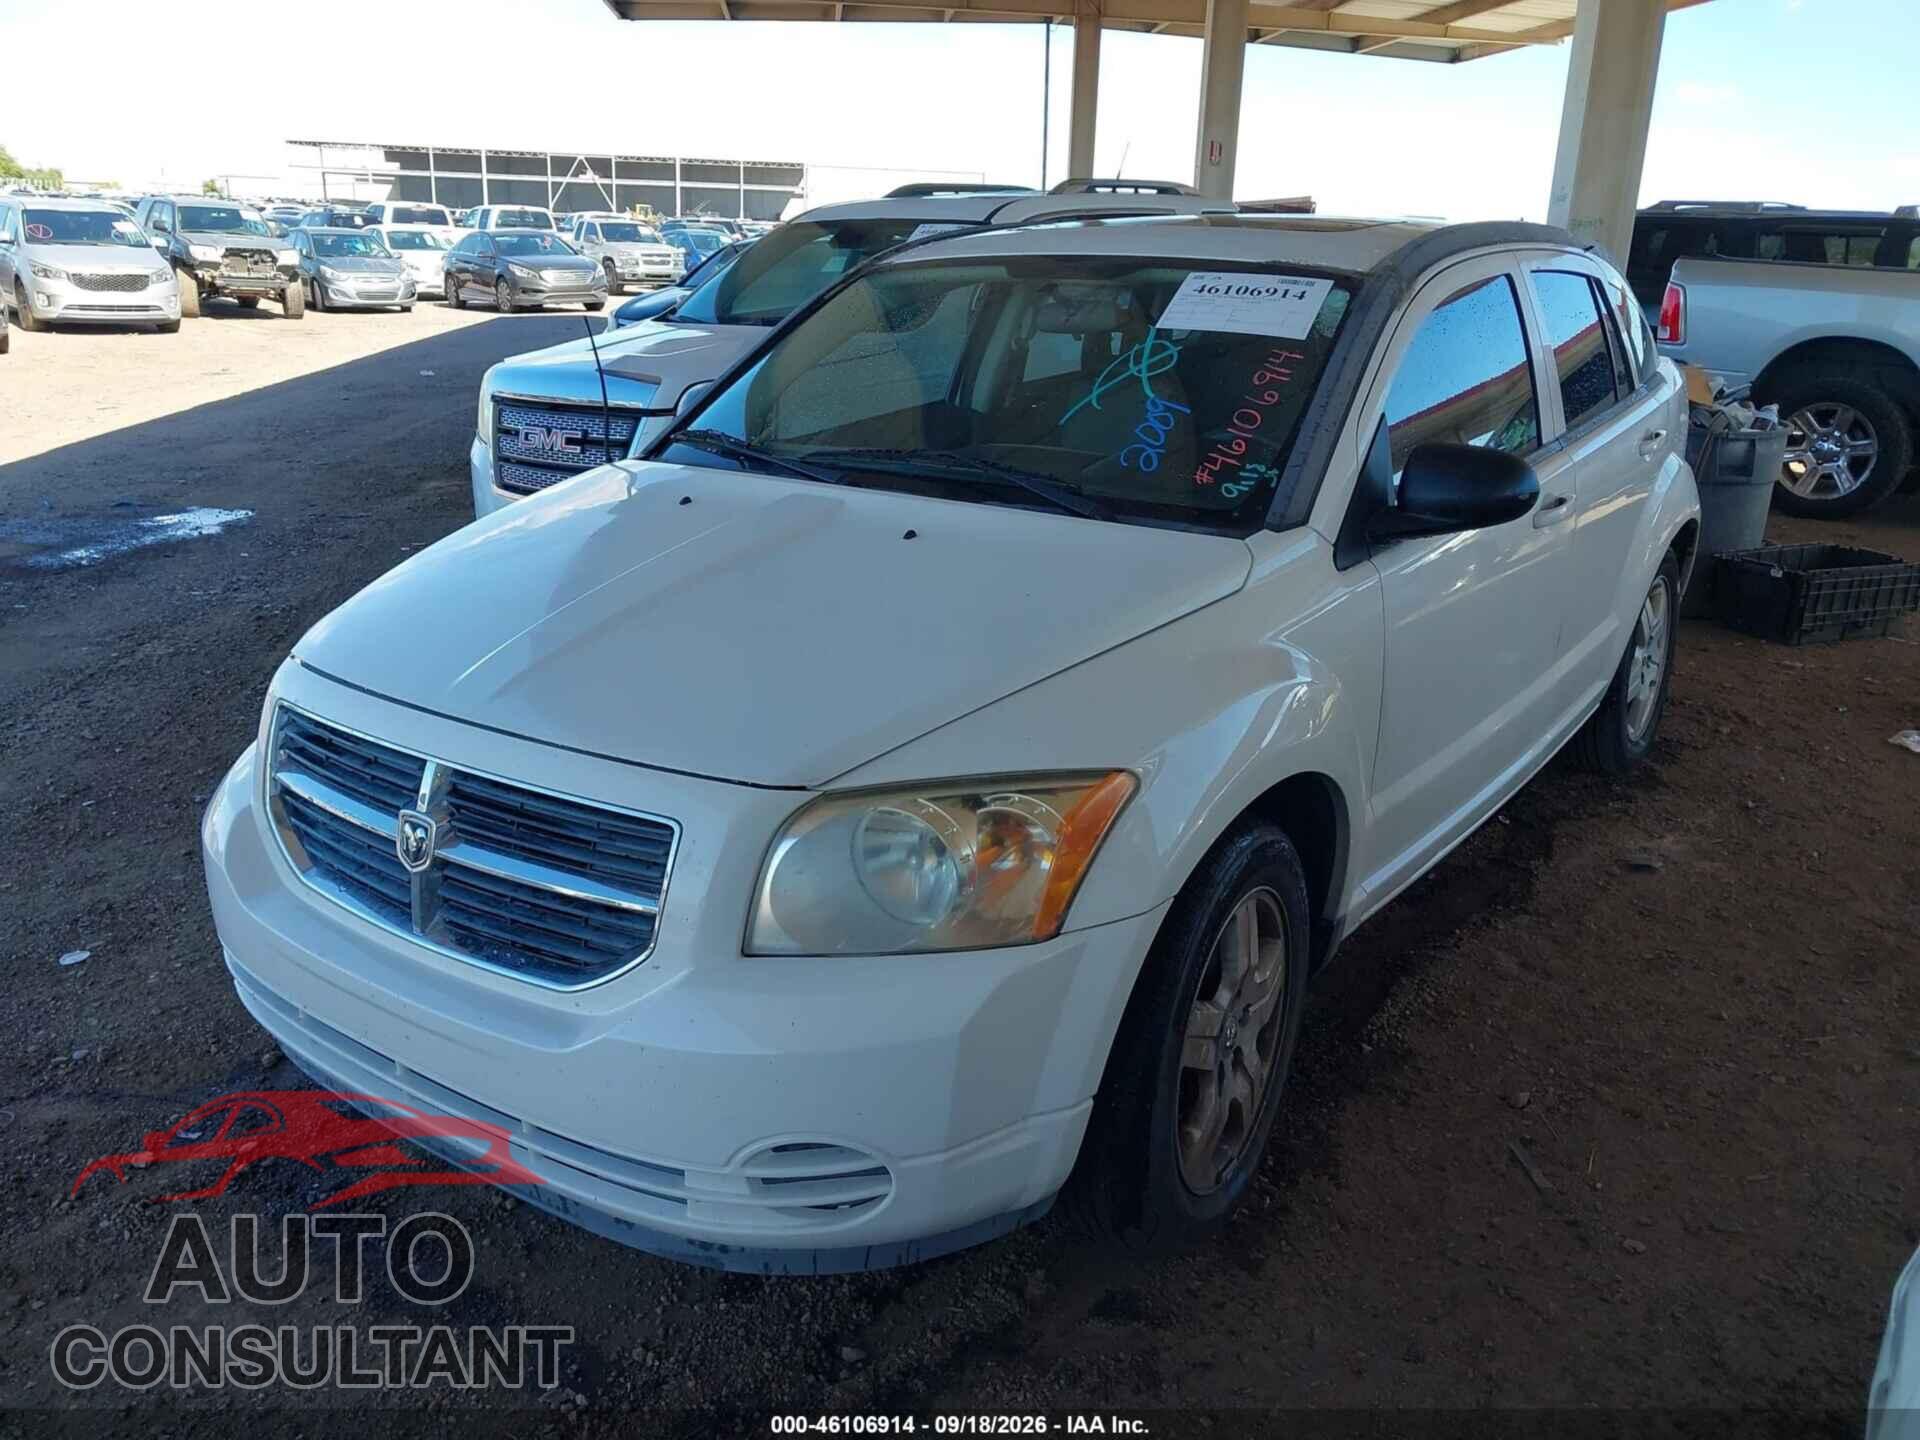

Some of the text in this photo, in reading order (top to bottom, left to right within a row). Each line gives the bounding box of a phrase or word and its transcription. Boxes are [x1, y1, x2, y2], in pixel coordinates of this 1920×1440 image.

[1192, 283, 1307, 301] 46106914
[1193, 348, 1305, 486] #46106914
[519, 425, 582, 453] GMC
